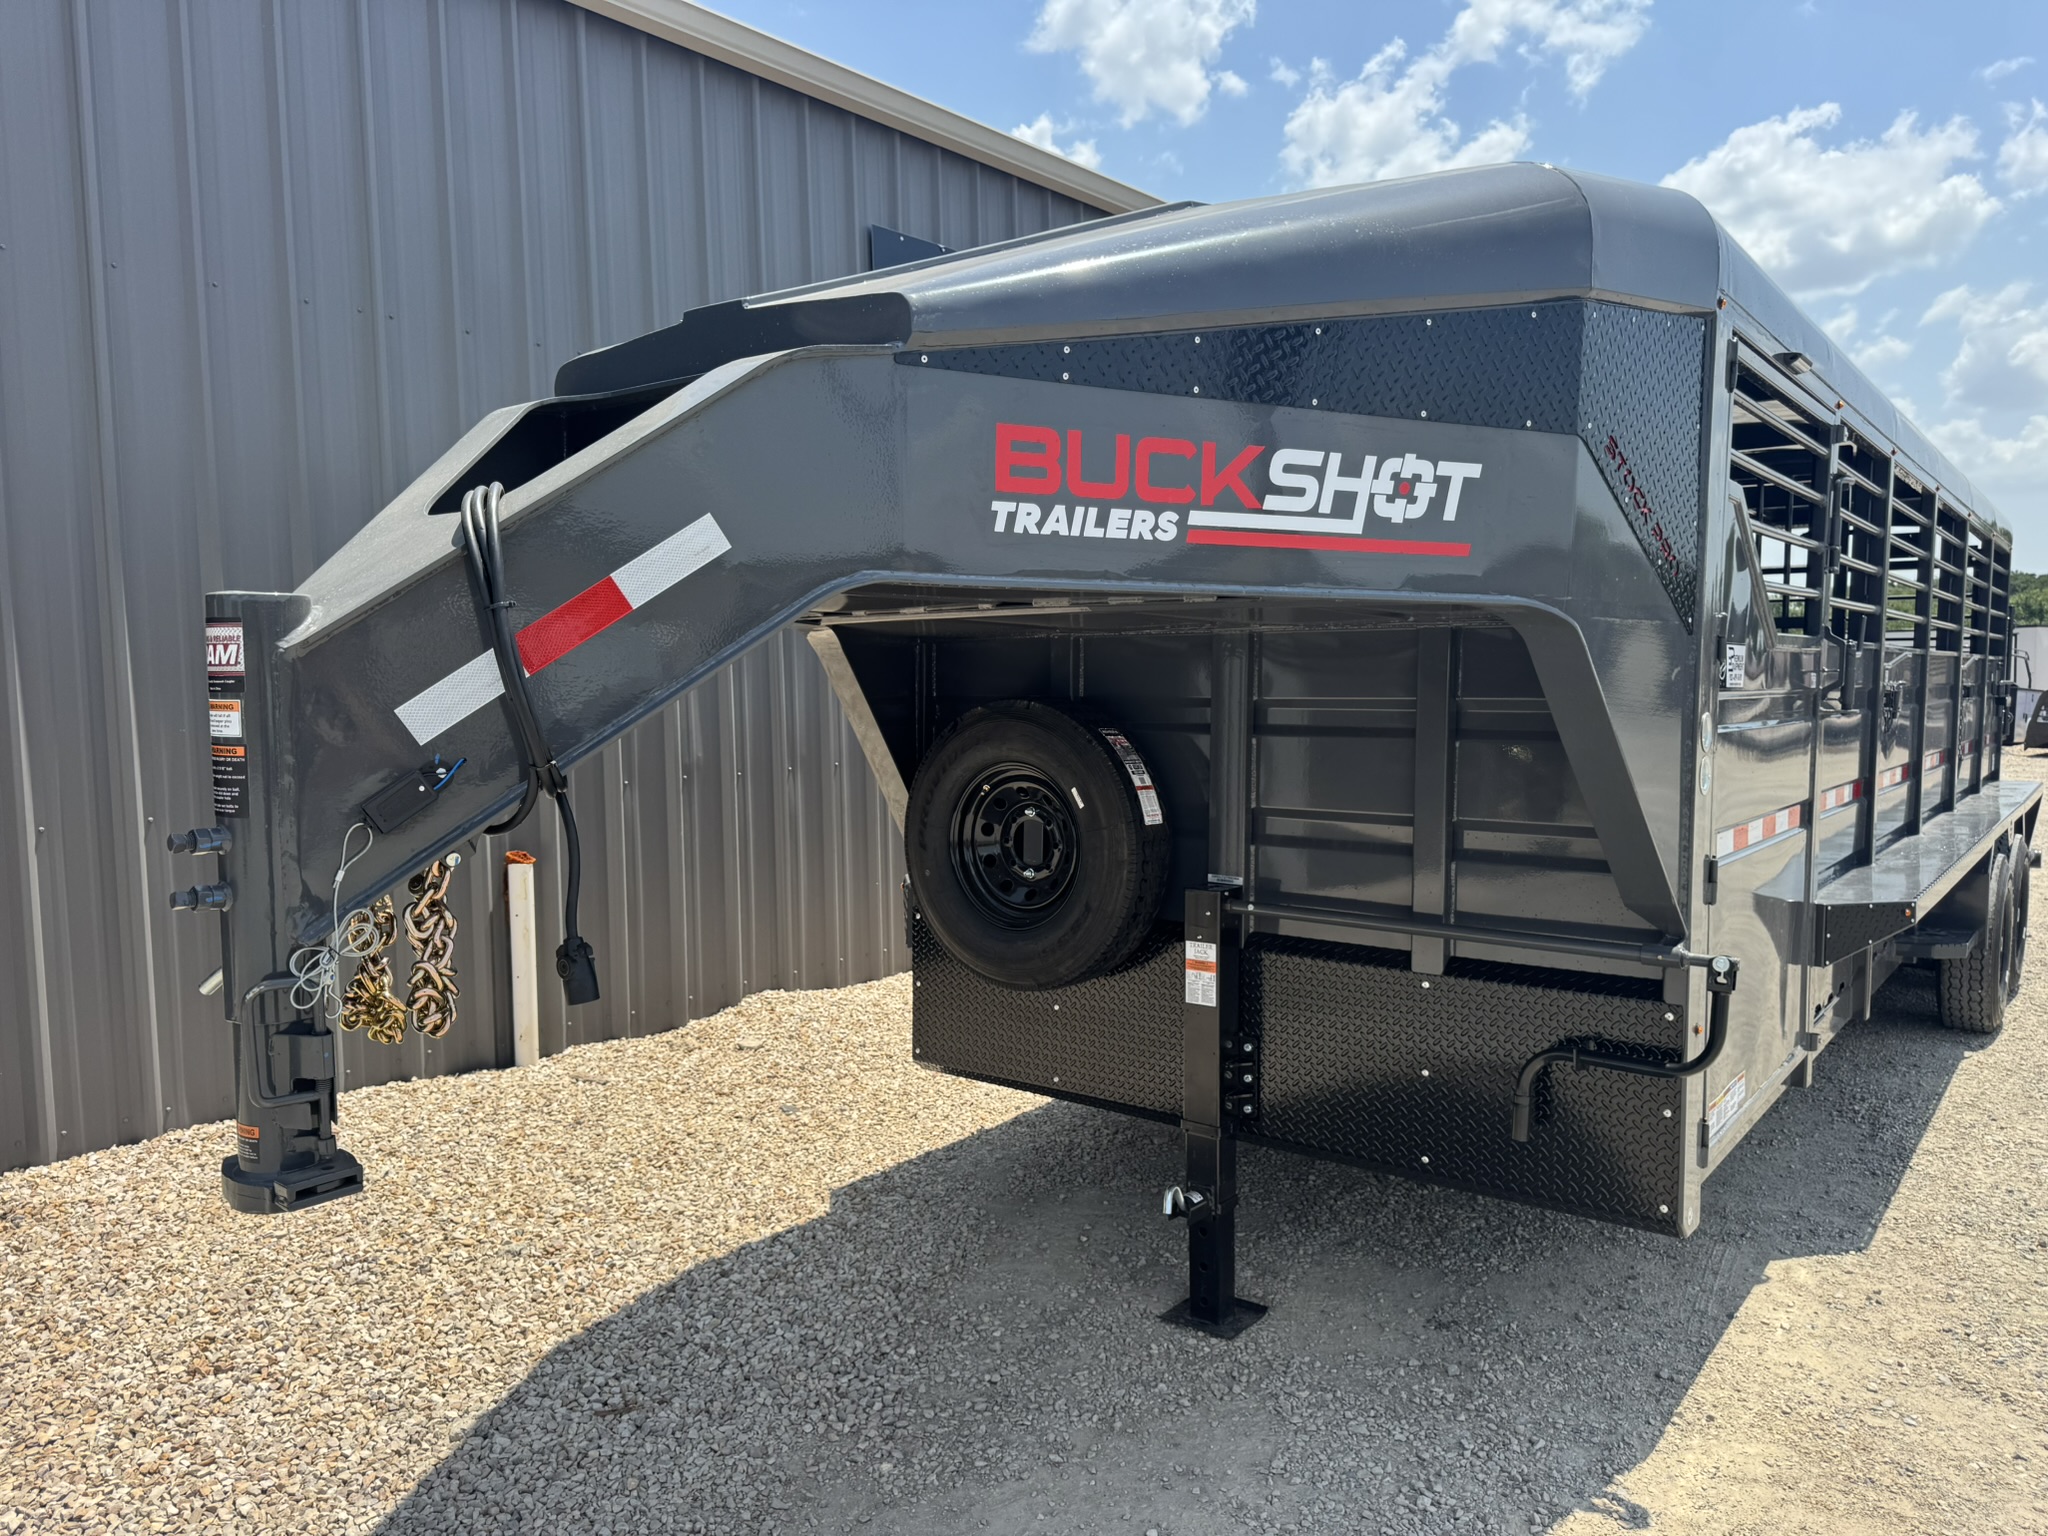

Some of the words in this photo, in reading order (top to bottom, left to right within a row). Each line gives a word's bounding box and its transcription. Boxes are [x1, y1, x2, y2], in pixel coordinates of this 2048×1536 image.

[1604, 435, 1652, 525] STOCK
[991, 501, 1180, 542] TRAILERS
[206, 644, 238, 665] AM
